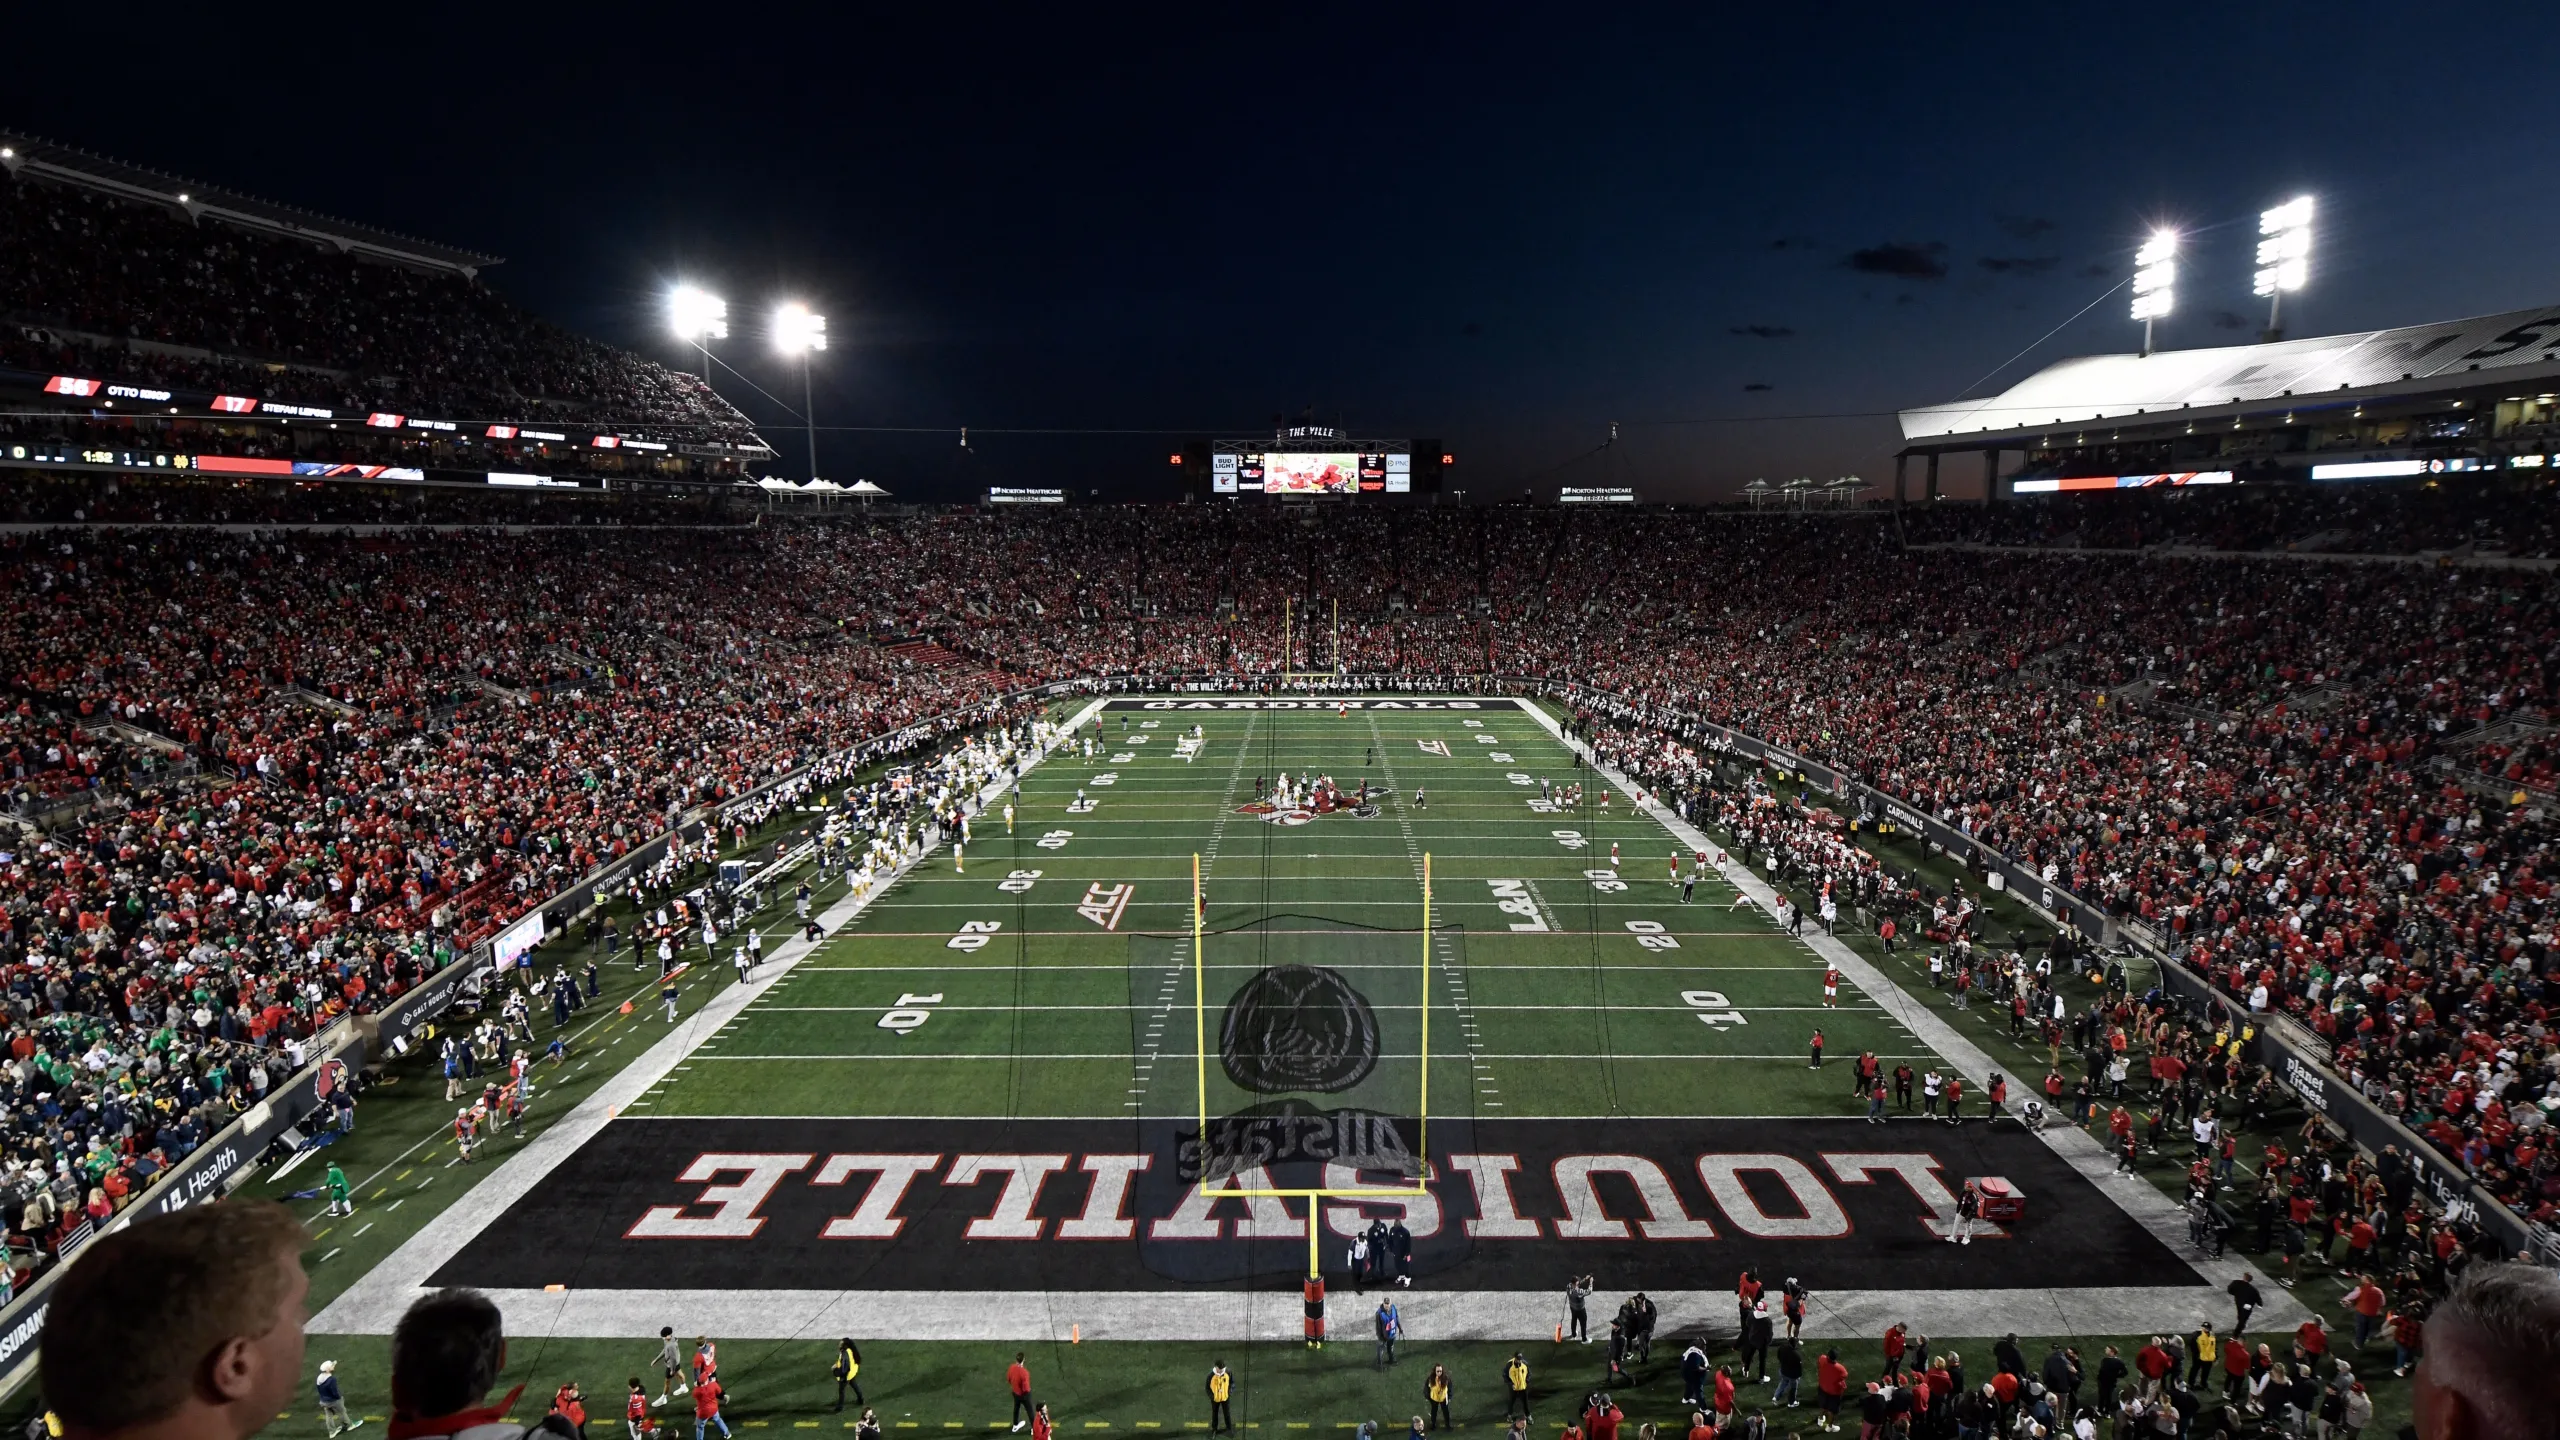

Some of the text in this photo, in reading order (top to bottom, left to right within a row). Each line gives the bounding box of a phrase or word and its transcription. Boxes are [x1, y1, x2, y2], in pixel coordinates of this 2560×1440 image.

[58, 376, 90, 396] 56
[107, 385, 139, 398] OTTO
[224, 396, 247, 412] 17
[262, 402, 298, 415] STEFAN
[1289, 427, 1334, 438] THE VILLE
[82, 450, 114, 464] 1:52
[688, 445, 720, 456] JOHNNY
[722, 448, 748, 458] UNITAS
[1170, 455, 1182, 464] 25
[1442, 455, 1453, 464] 25
[1186, 682, 1200, 692] THE
[1143, 701, 1482, 709] CARDINALS
[1526, 799, 1560, 813] 50
[1886, 803, 1924, 831] CARDINALS
[1036, 829, 1074, 848] 40
[1551, 830, 1589, 848] 40
[997, 869, 1044, 891] 30
[1582, 869, 1629, 891] 30
[1076, 881, 1126, 927] ACC
[1486, 879, 1550, 932] L&N
[946, 920, 1002, 949] 20
[1624, 920, 1682, 948] 20
[412, 989, 446, 1018] GALT HOUSE
[877, 992, 944, 1029] 10
[1680, 990, 1749, 1026] 10
[2286, 1057, 2324, 1093] planet
[2289, 1071, 2328, 1110] fitness
[188, 1146, 237, 1199] Health
[622, 1151, 2012, 1240] LOUISVILLE
[2430, 1170, 2480, 1224] Health
